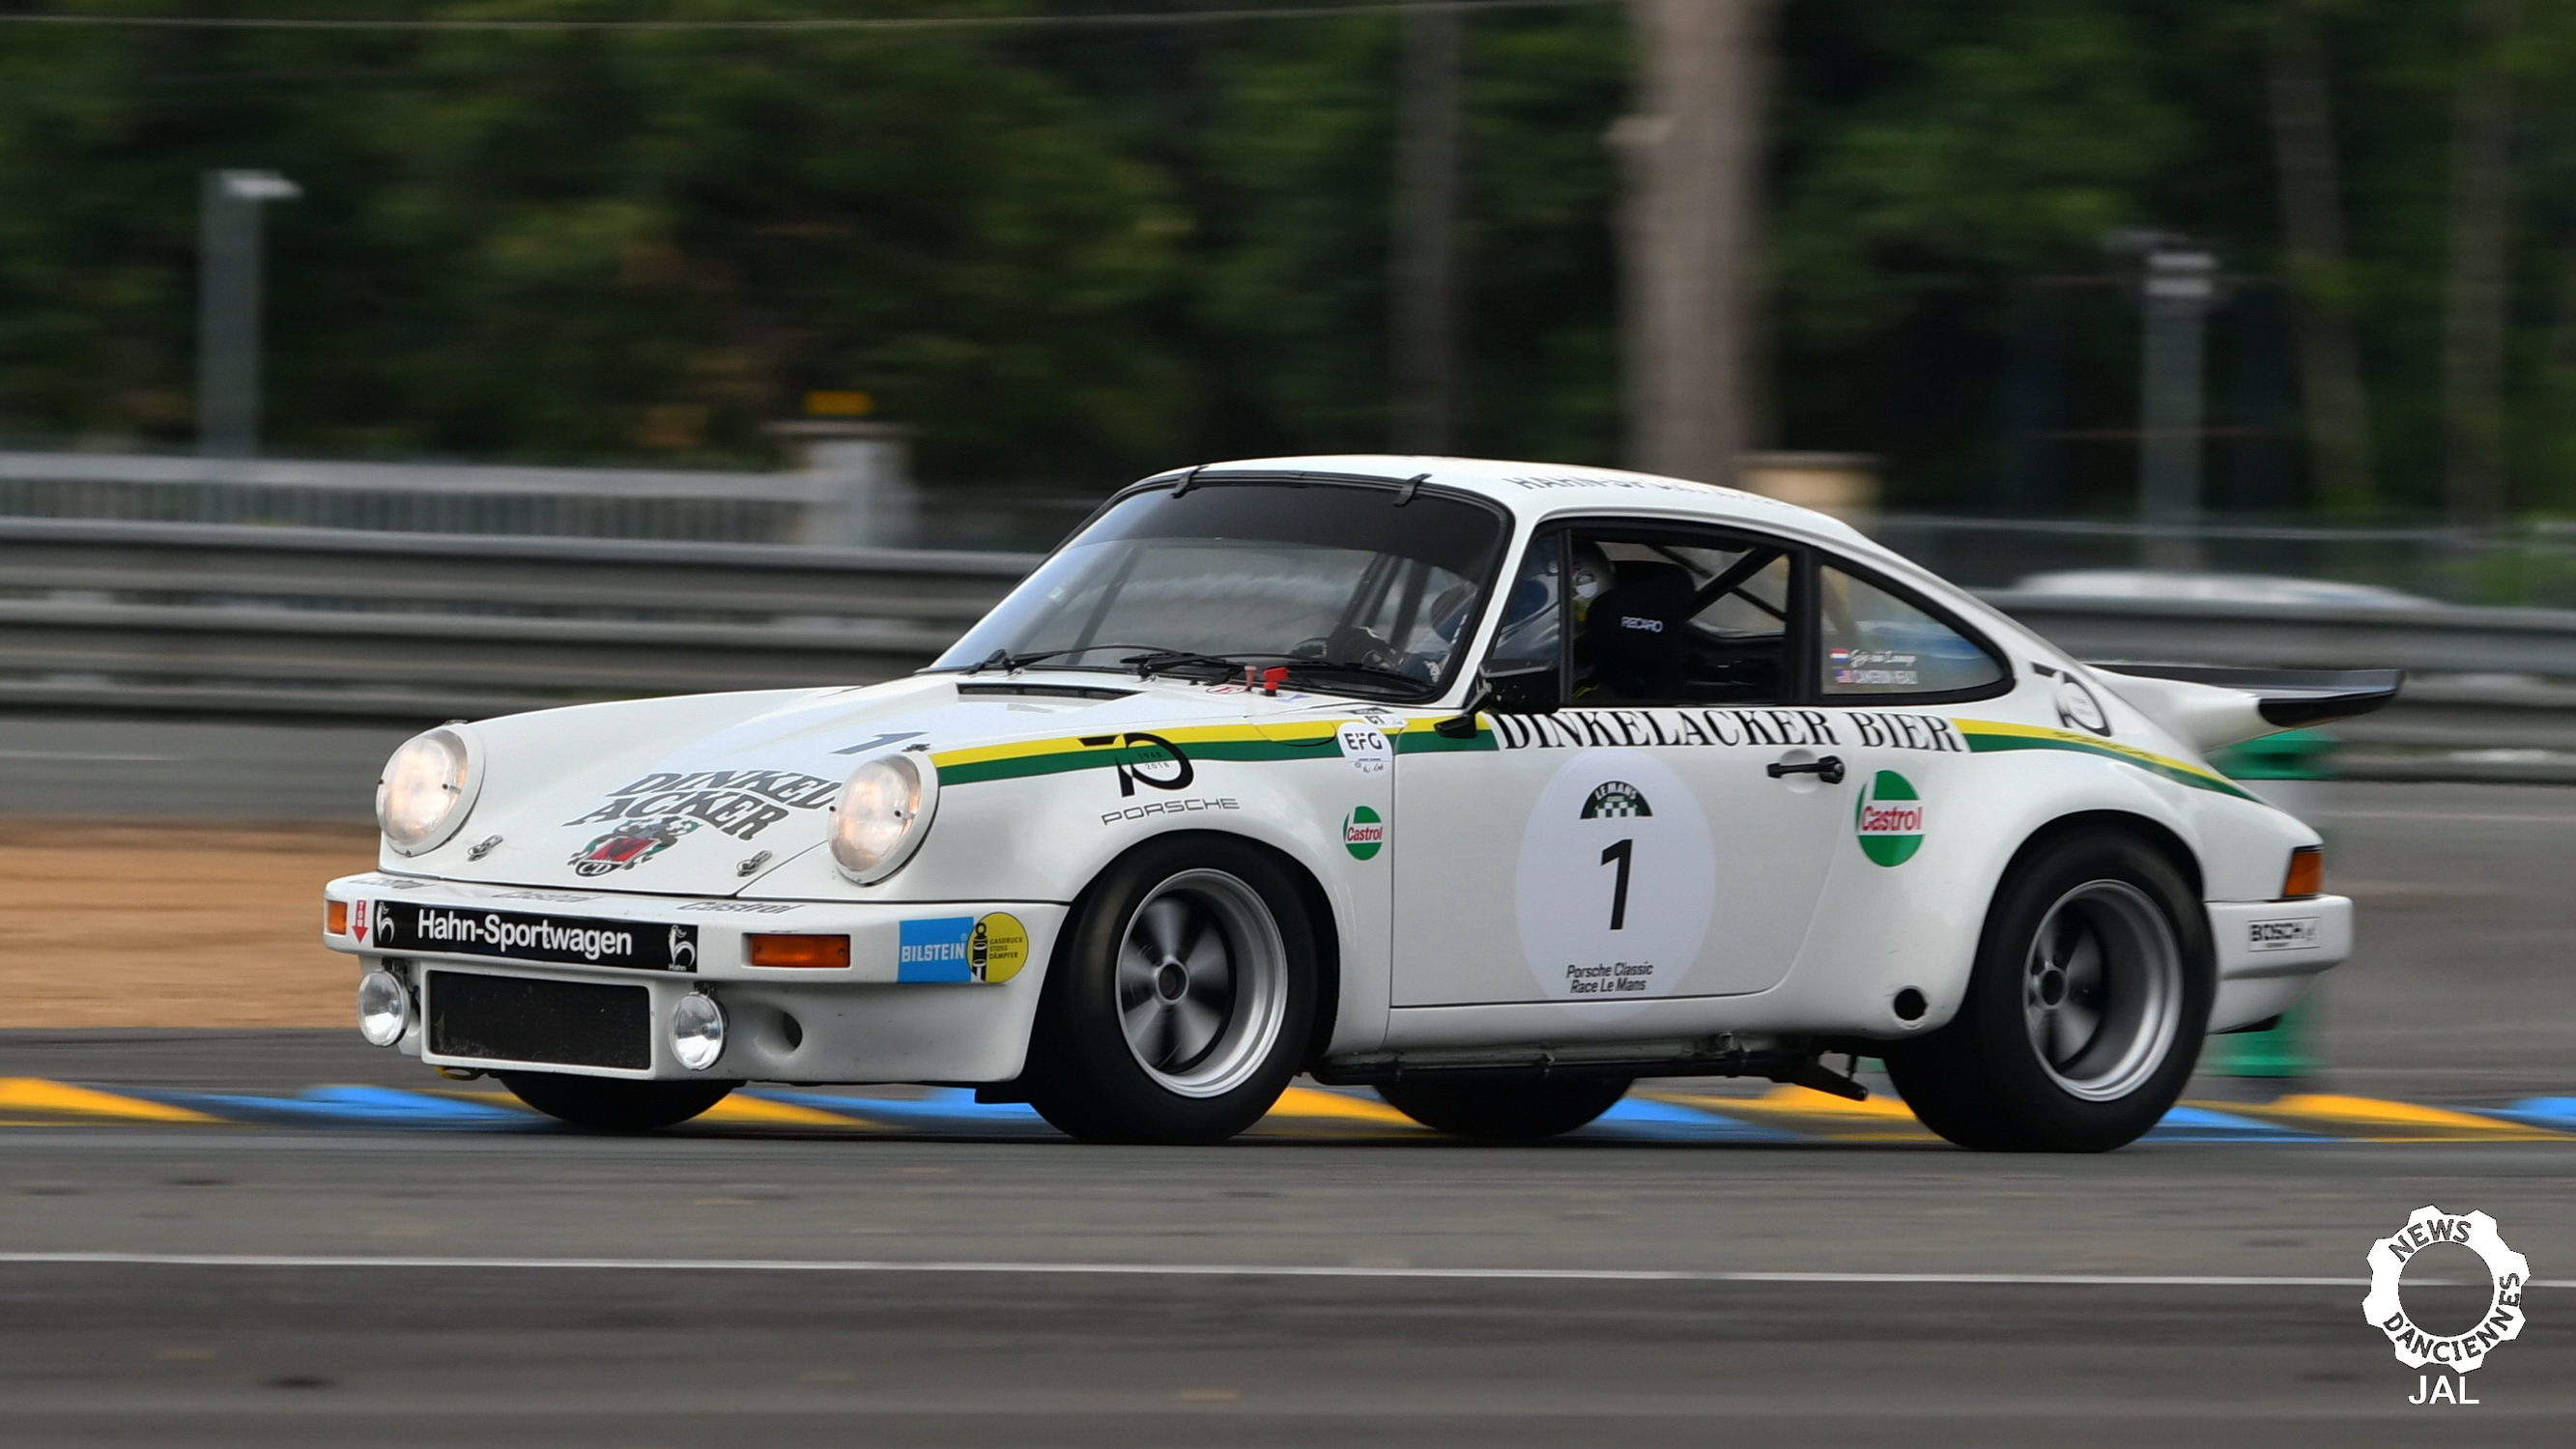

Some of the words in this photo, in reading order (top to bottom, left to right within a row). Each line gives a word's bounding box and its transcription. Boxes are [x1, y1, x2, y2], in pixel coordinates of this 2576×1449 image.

[1620, 616, 1663, 633] RECARO
[1344, 732, 1383, 750] EFG
[1492, 710, 1841, 750] DINKELACKER
[1843, 711, 1962, 753] BIER
[830, 731, 930, 755] 1
[1145, 762, 1170, 771] 2018
[605, 770, 842, 810] DINKEL
[560, 790, 789, 841] ACKER
[1102, 798, 1241, 826] PORSCHE
[1862, 806, 1923, 831] Castrol
[1347, 826, 1383, 841] Castrol
[1600, 838, 1633, 930] 1
[675, 901, 806, 915] Castrol
[417, 908, 633, 960] Hahn-Sportwagen
[989, 936, 1023, 945] GASDRUCK
[901, 942, 965, 963] BILSTEIN
[988, 952, 1018, 960] DÄMPFER
[1565, 963, 1612, 979] Porsche
[1614, 961, 1653, 976] Classic
[1569, 979, 1598, 993] Race
[1600, 978, 1614, 992] Le
[1615, 977, 1646, 991] Mans
